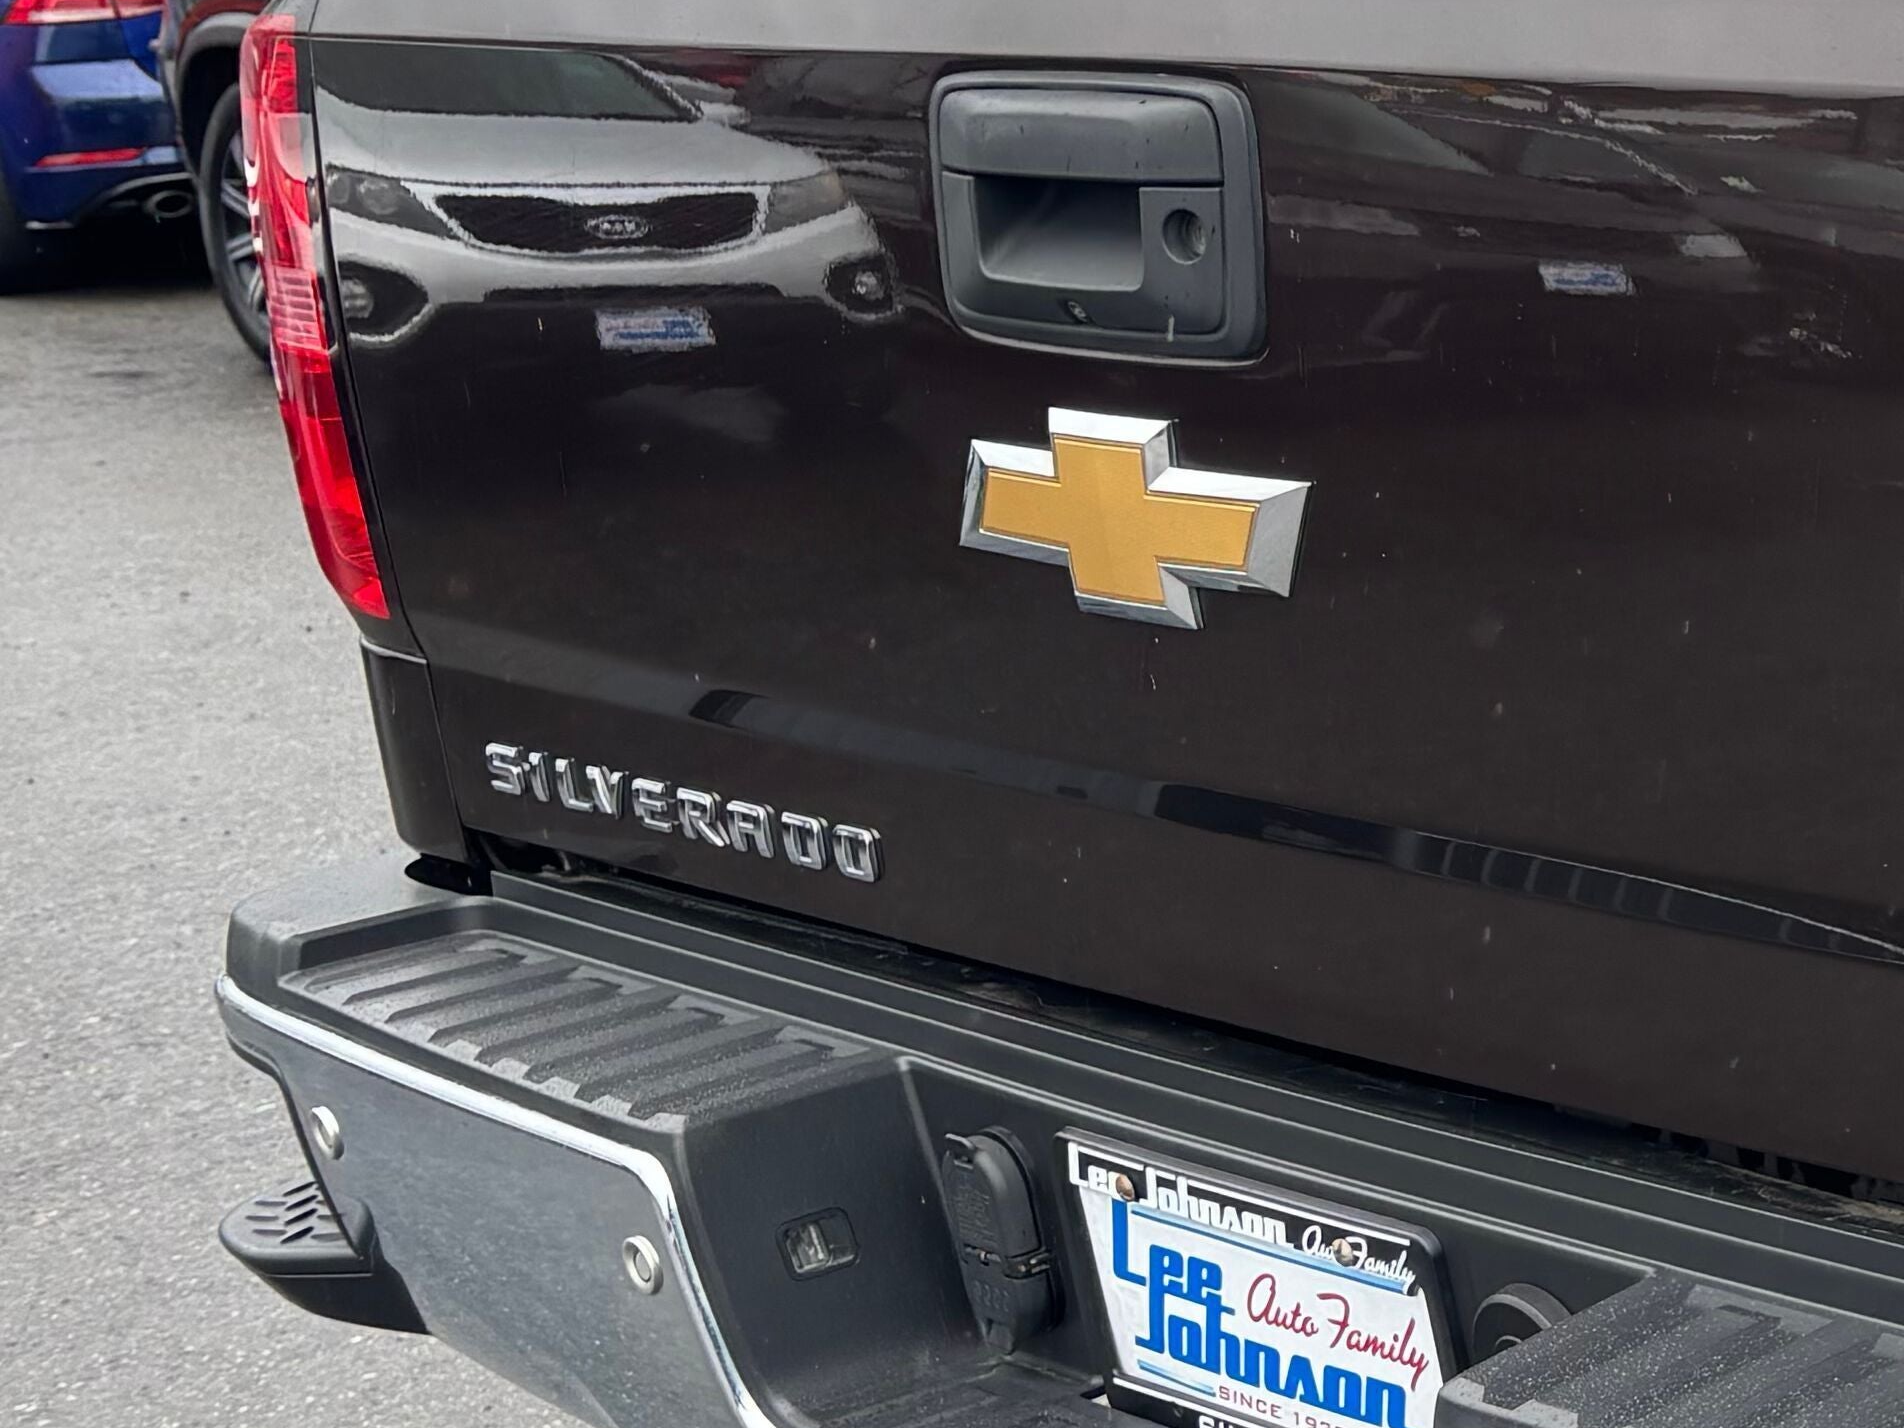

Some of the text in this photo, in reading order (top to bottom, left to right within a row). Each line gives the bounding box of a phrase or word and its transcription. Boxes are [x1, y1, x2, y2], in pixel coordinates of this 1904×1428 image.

[485, 741, 883, 884] SILVERADO
[1112, 1198, 1223, 1302] Lee
[1139, 1166, 1294, 1250] Johnson
[1246, 1273, 1429, 1392] Auto Family
[1218, 1385, 1283, 1420] SINCE
